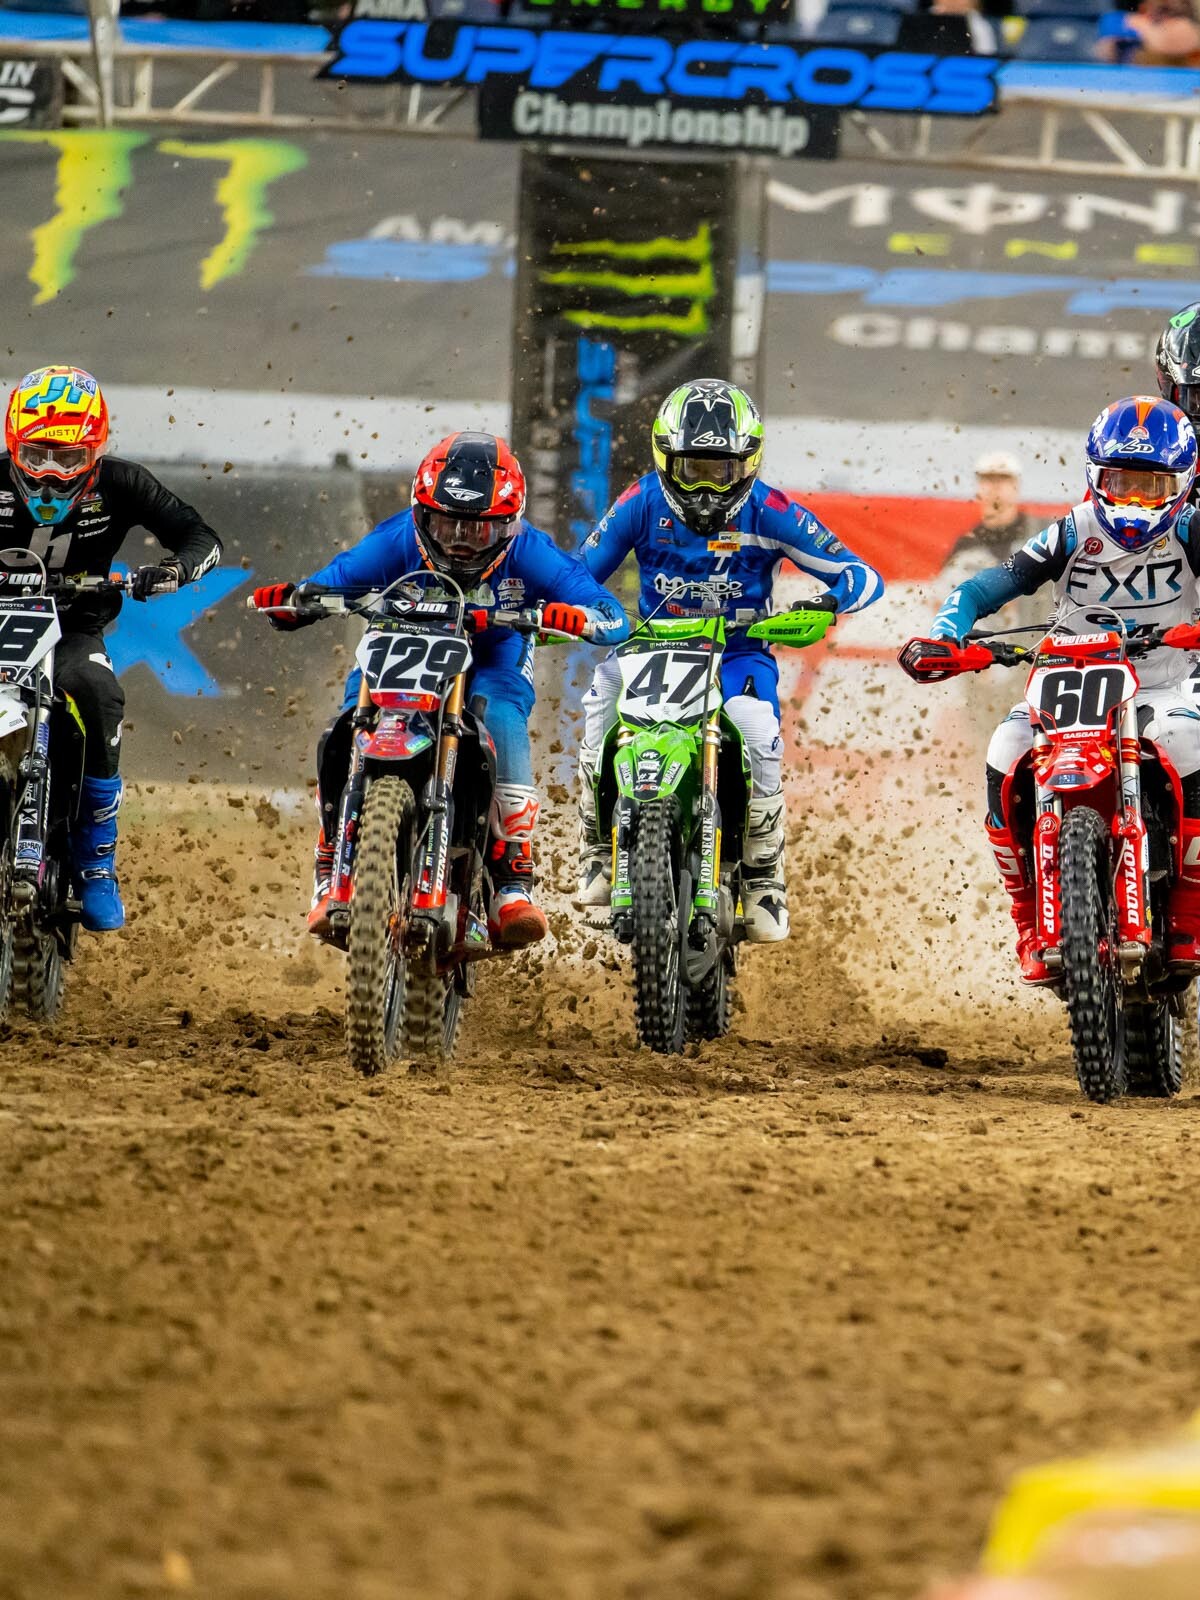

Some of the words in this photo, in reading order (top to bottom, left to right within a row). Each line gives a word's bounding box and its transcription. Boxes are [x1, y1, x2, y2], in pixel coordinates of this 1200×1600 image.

[330, 19, 999, 114] SUPERCROSS
[513, 93, 810, 155] Championship
[1066, 558, 1183, 603] FXR
[768, 627, 803, 635] CIRCUIT
[1054, 633, 1109, 646] PROTAPER
[366, 636, 470, 692] 129
[626, 652, 711, 707] 47
[1041, 668, 1126, 729] 60
[1063, 731, 1101, 740] GASGAS
[700, 860, 713, 884] TOP
